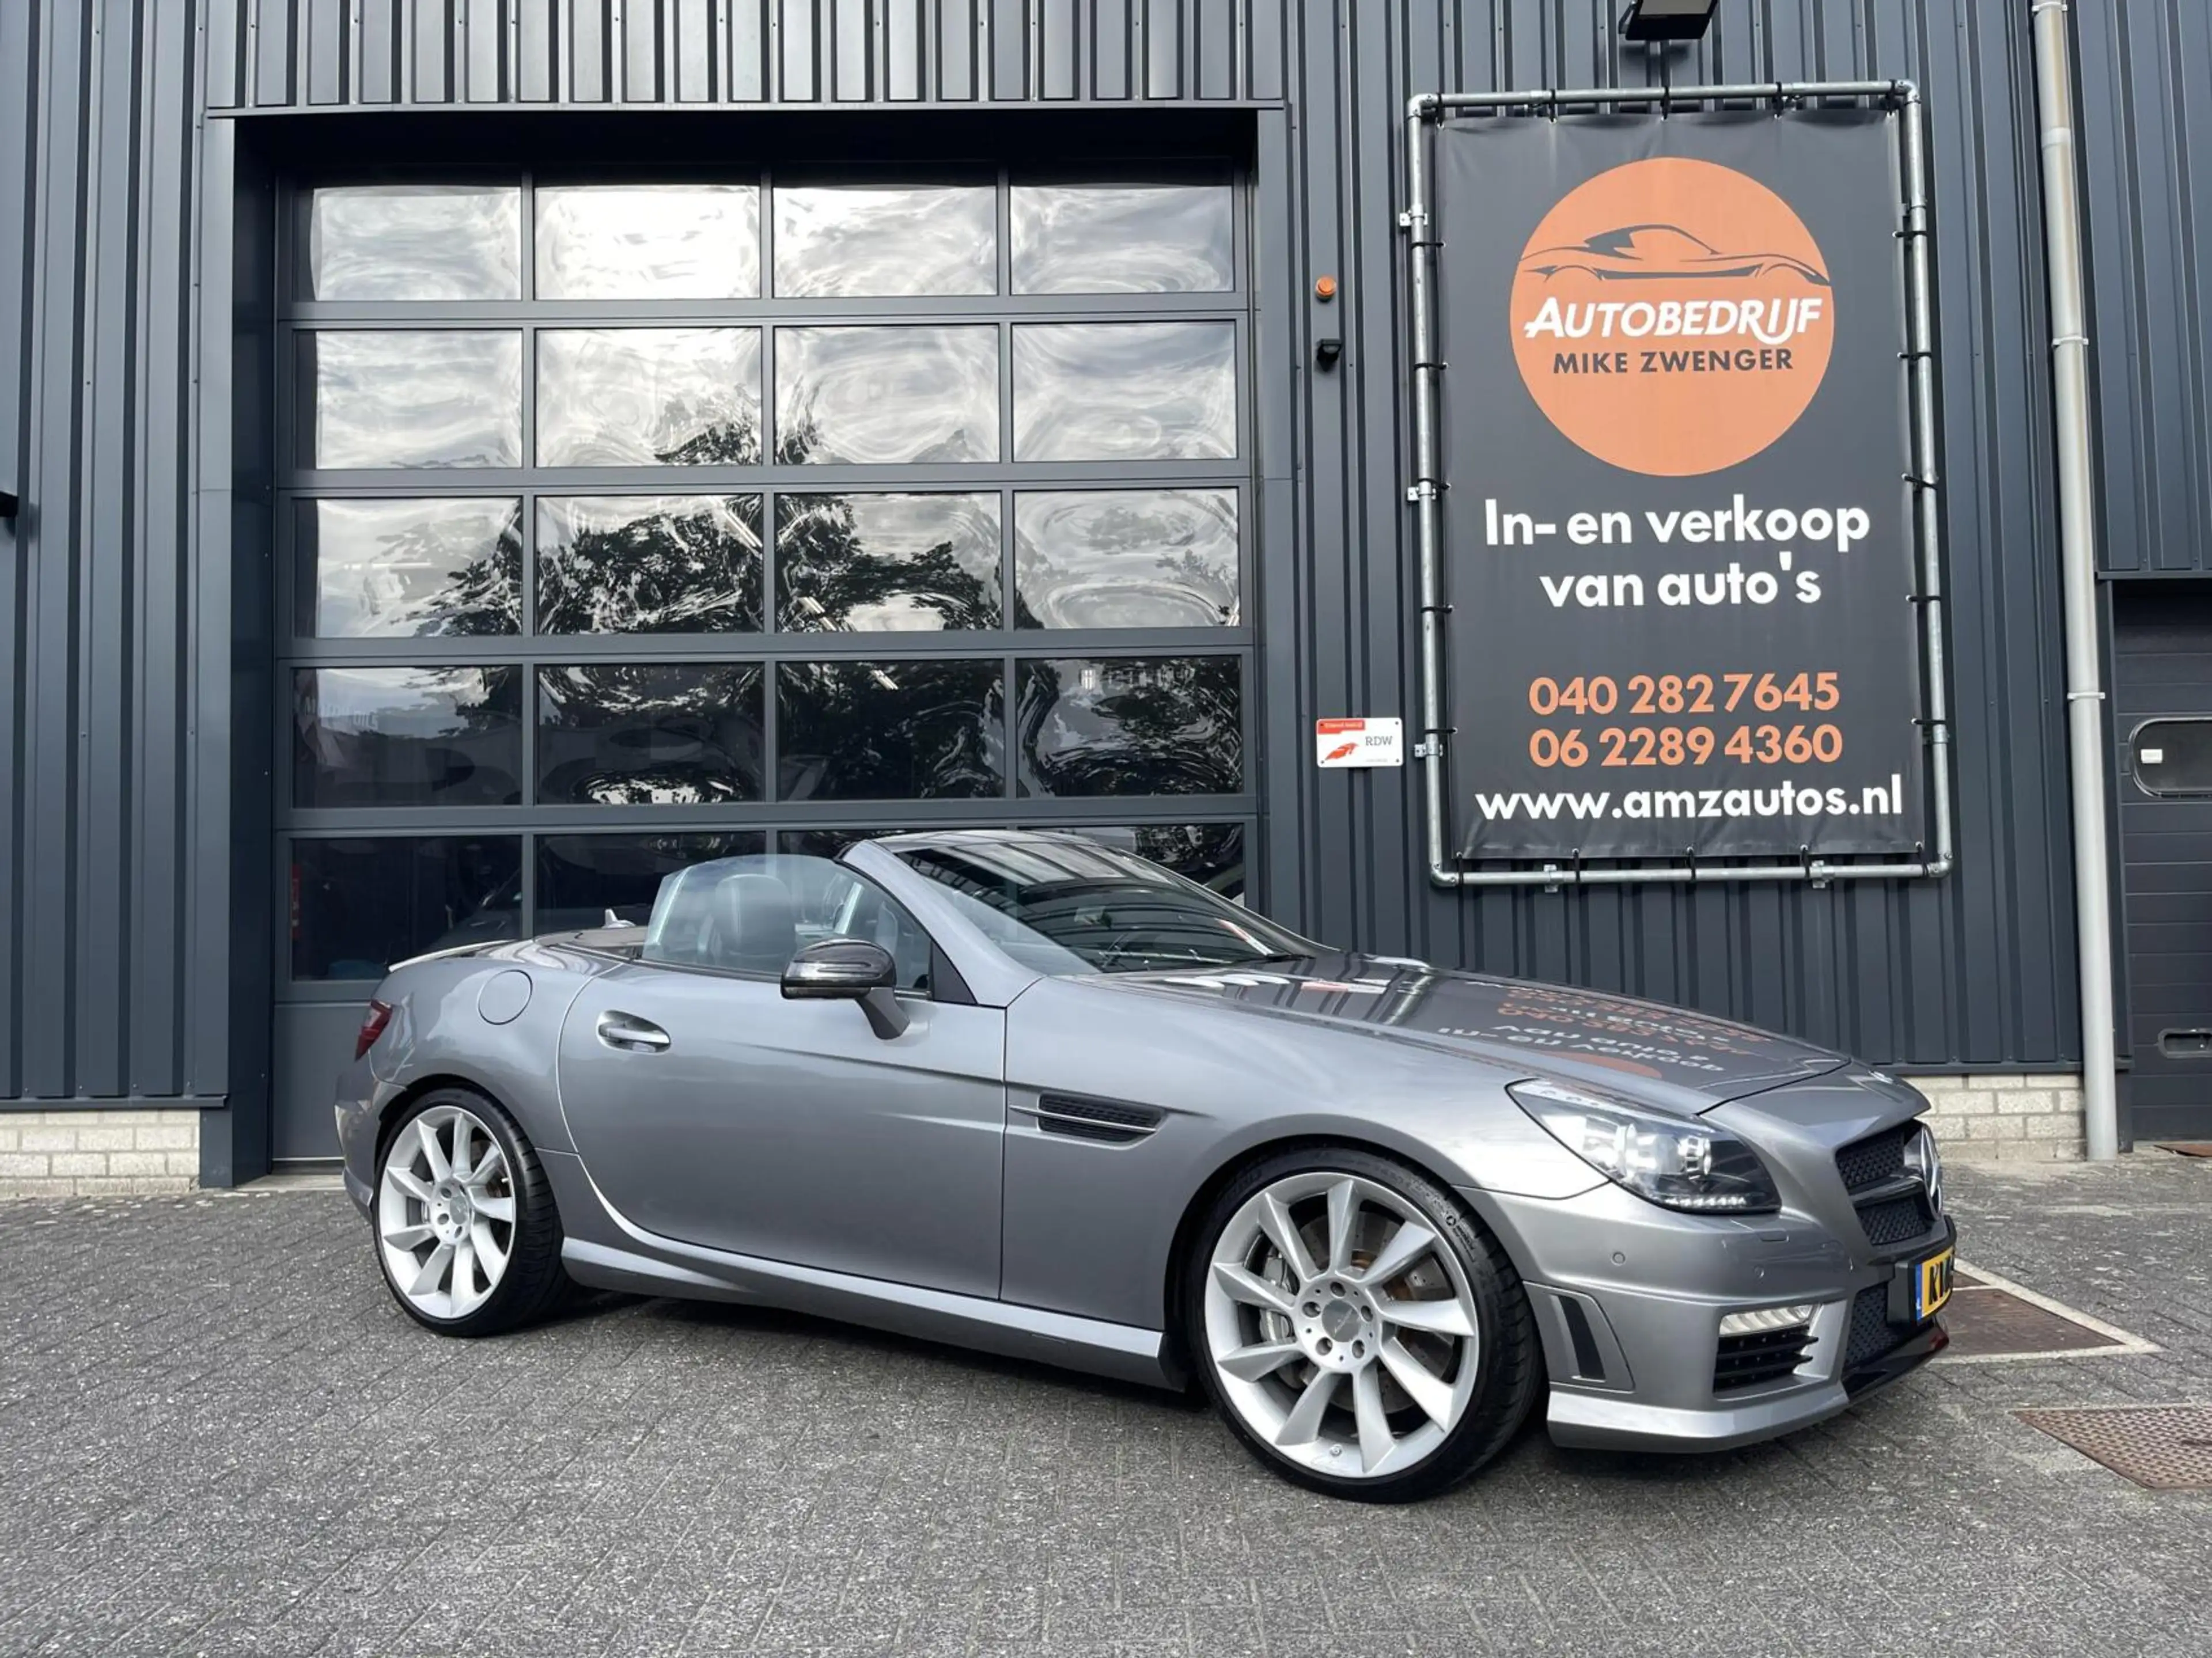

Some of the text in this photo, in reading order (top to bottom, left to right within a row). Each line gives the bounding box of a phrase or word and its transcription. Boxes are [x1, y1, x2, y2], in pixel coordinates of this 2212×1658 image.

[1553, 348, 1793, 374] MIKE ZWENGER
[1484, 493, 1870, 553] In- en verkoop
[1539, 551, 1821, 608] van auto's
[1529, 672, 1839, 715] 040 282 7645
[1365, 735, 1393, 746] RDW
[1529, 724, 1843, 767] 06 2289 4360
[1475, 773, 1903, 821] www.amzautos.nl
